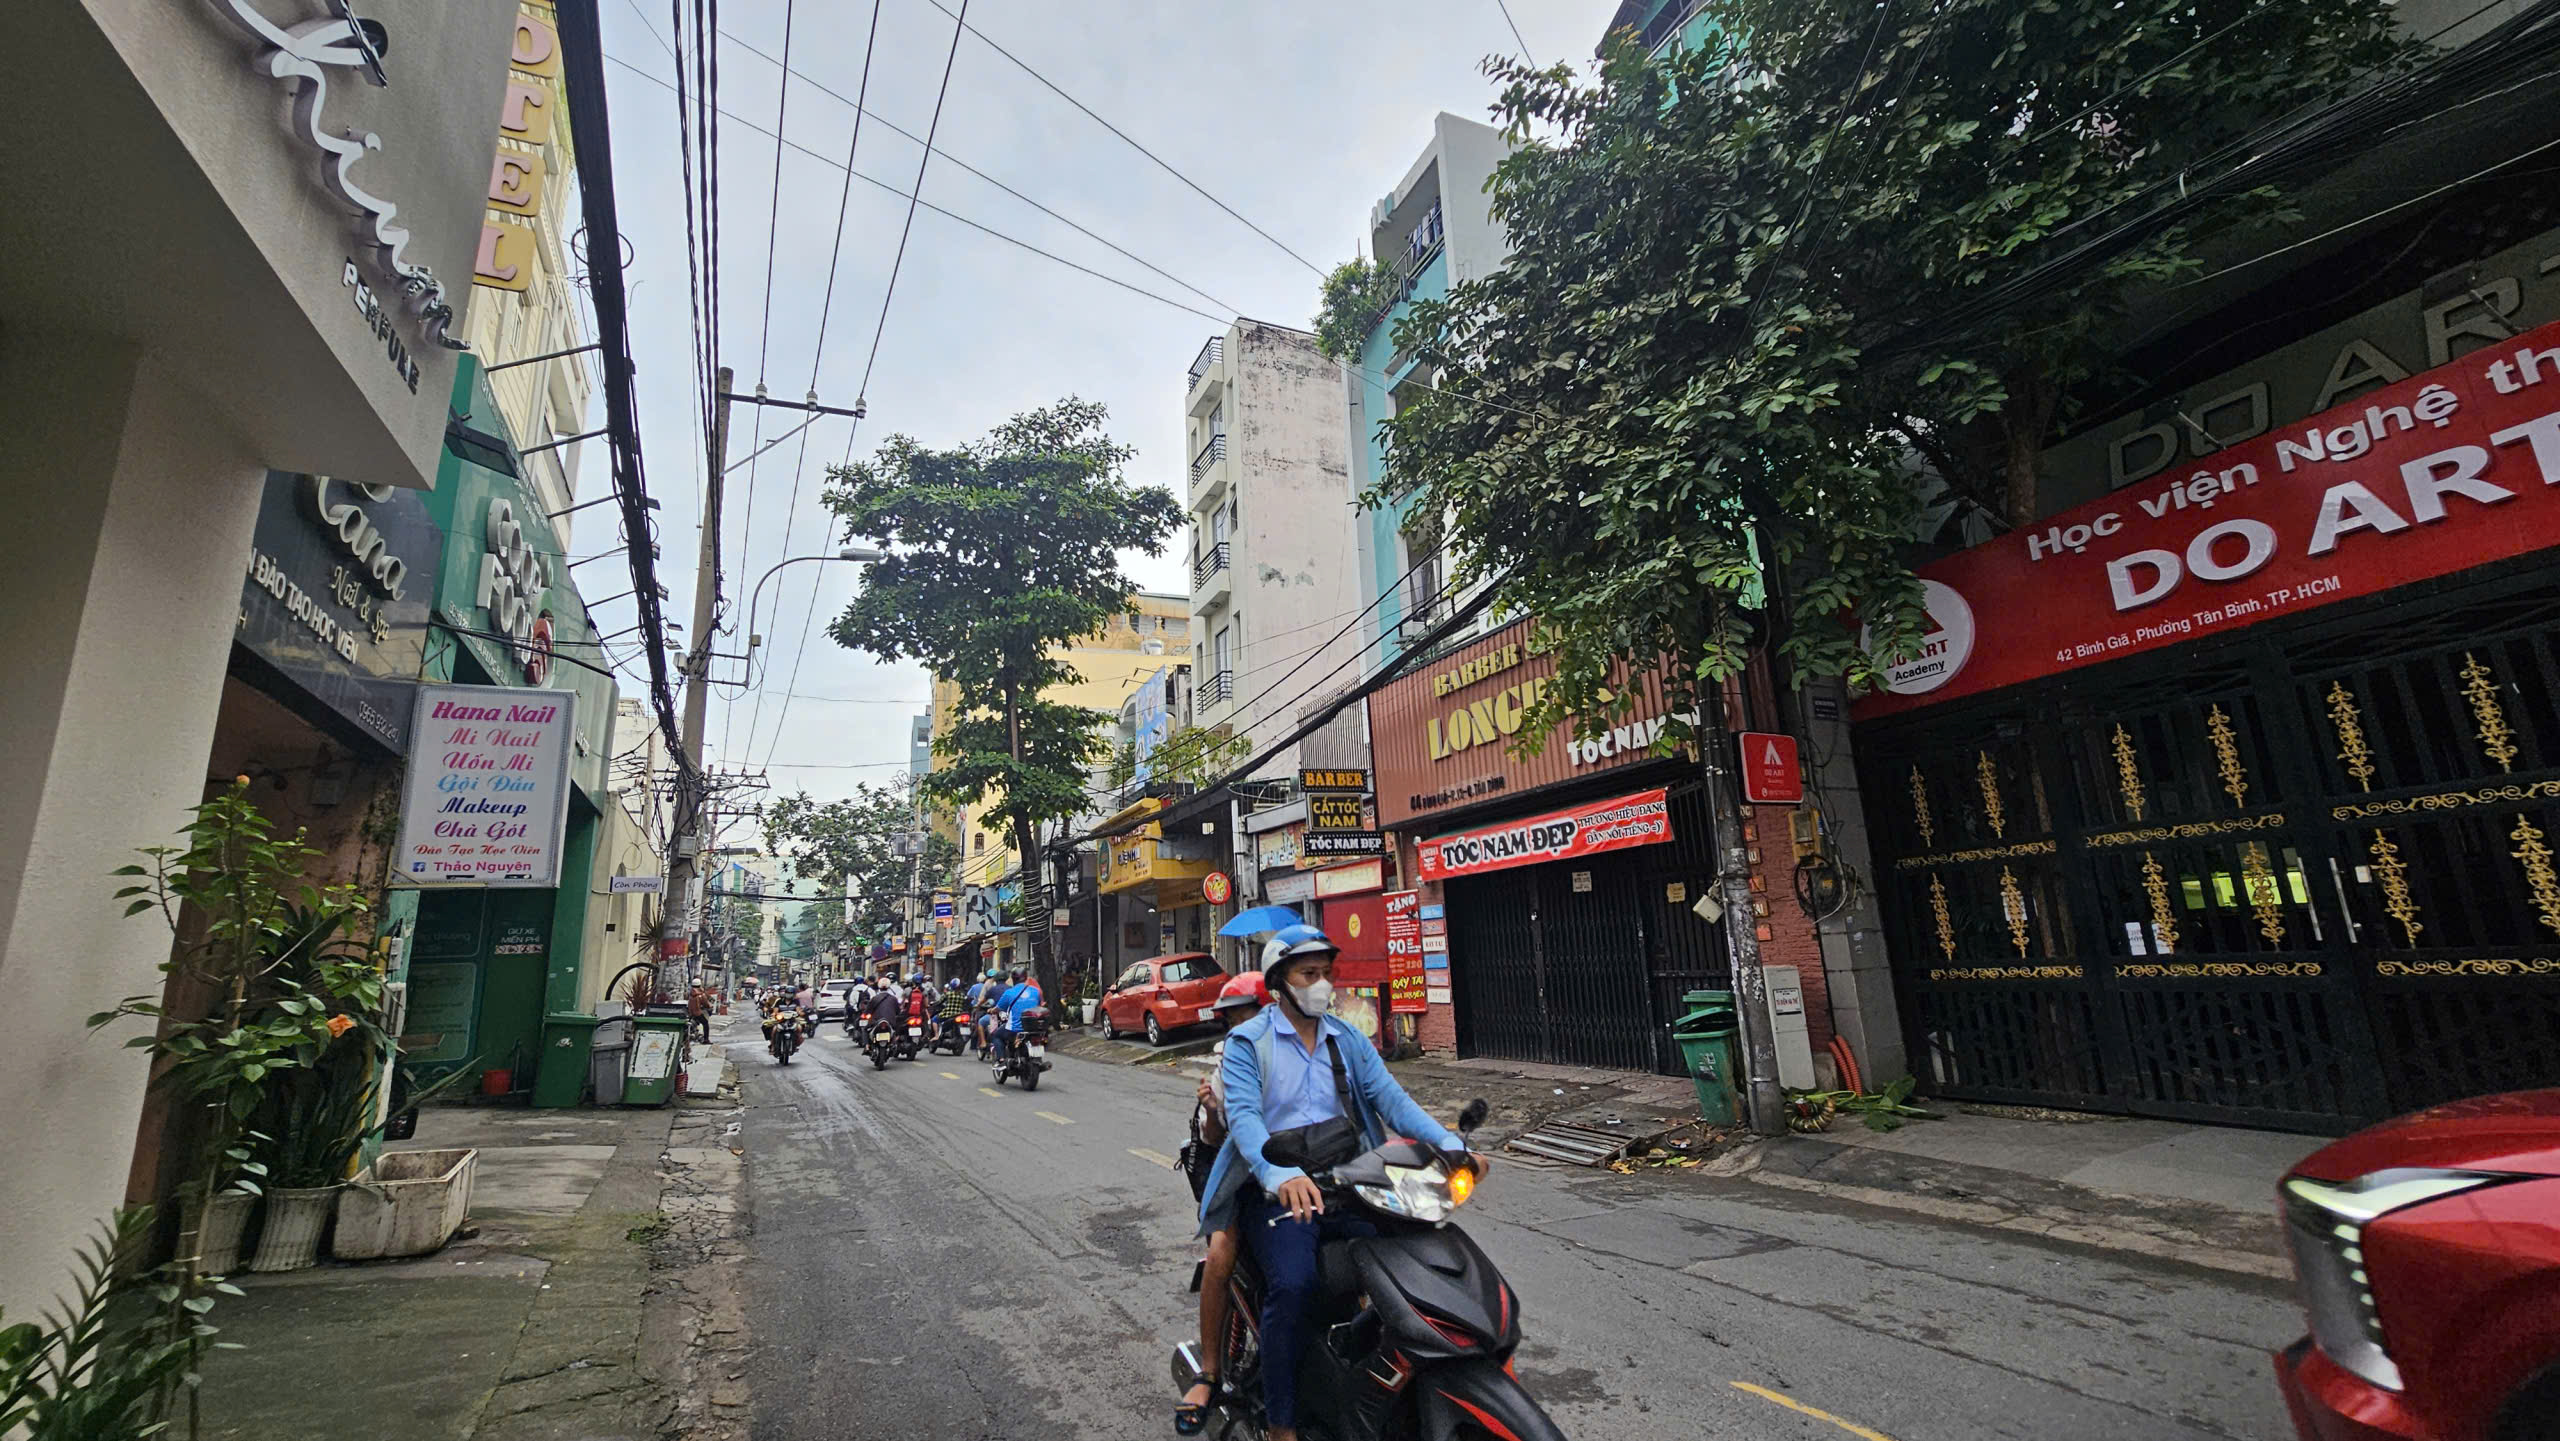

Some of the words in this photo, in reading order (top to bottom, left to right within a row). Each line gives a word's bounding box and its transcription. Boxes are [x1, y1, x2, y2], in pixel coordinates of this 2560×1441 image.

[342, 256, 420, 395] PERFUME
[2109, 382, 2269, 490] DO
[2310, 253, 2560, 415] AR
[2027, 512, 2124, 562] Học
[2138, 463, 2260, 518] viện
[2276, 384, 2459, 473] Nghệ
[2106, 518, 2278, 612] DO
[2308, 411, 2560, 556] ART
[257, 557, 287, 600] ĐÀO
[286, 581, 312, 622] TẠO
[311, 604, 335, 643] HỌC
[330, 565, 362, 609] Nail
[371, 608, 391, 645] Spa
[2056, 650, 2073, 663] 42
[2193, 608, 2223, 627] Tân
[2225, 600, 2261, 619] Bình
[1434, 643, 1520, 697] BARBER
[1895, 661, 1945, 681] Academy
[431, 701, 501, 721] Hana
[505, 703, 556, 724] Nail
[443, 727, 479, 746] Mi
[486, 728, 541, 748] Nail
[442, 751, 495, 771] Uốn
[501, 752, 534, 771] Mi
[436, 773, 480, 794] Gội
[1305, 772, 1363, 786] BARBER
[437, 797, 528, 818] Makeup
[1312, 796, 1335, 814] CẮT
[1336, 799, 1360, 814] TÓC
[1615, 805, 1638, 819] HIỆU
[434, 820, 476, 839] Chà
[486, 821, 528, 842] Gót
[1319, 815, 1357, 828] NAM
[413, 844, 443, 856] Đào
[447, 844, 475, 857] Tạo
[480, 844, 506, 857] Học
[1309, 836, 1333, 850] TÓC
[1333, 838, 1360, 849] NAM
[1360, 837, 1382, 852] ĐẸP
[1442, 837, 1479, 868] TÓC
[1482, 831, 1528, 860] NAM
[1530, 820, 1577, 855] ĐẸP
[433, 860, 472, 873] Thảo
[476, 861, 532, 874] Nguyên
[632, 881, 659, 889] Phòng
[1387, 939, 1406, 955] 90
